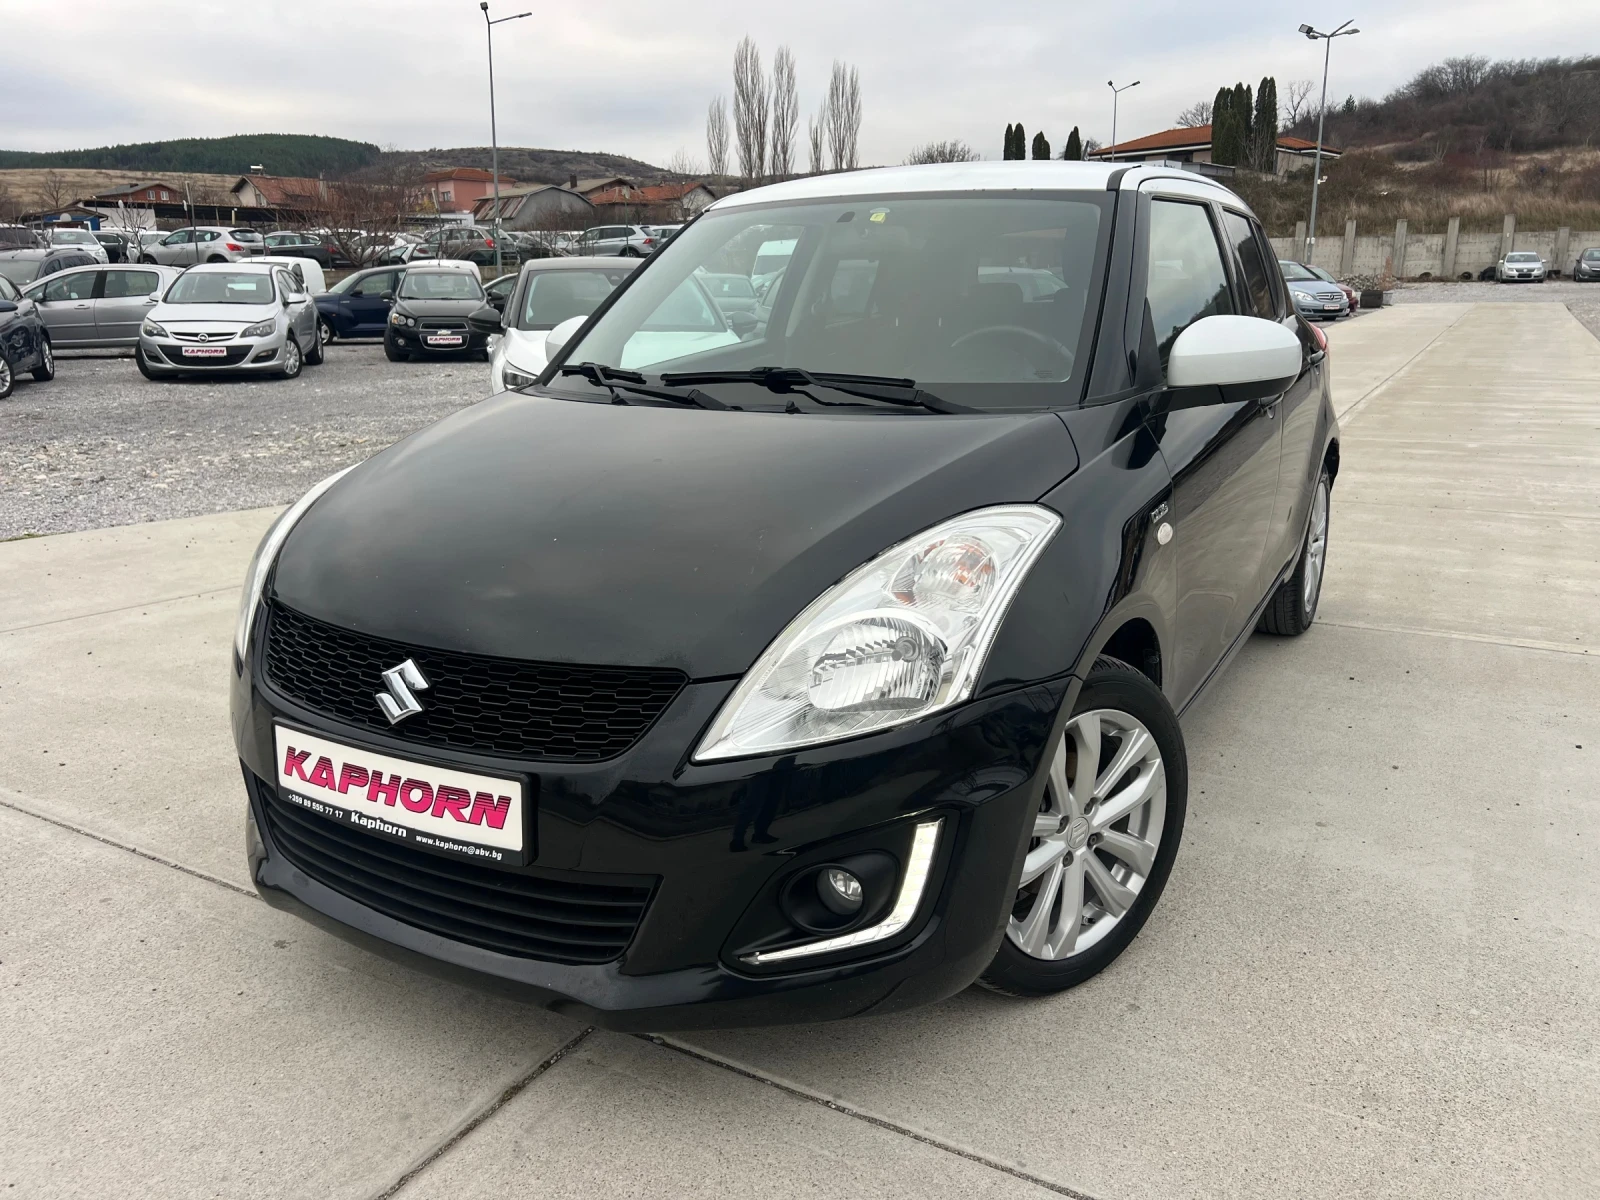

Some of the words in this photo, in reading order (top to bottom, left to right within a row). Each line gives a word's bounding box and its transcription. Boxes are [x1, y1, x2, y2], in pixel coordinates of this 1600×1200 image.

[284, 746, 511, 830] KAPHORN
[288, 794, 303, 804] +359
[325, 807, 333, 815] 77
[335, 810, 343, 819] 17
[350, 811, 407, 838] Kaphorn
[415, 835, 502, 861] www.kaphorn@abv.bg
